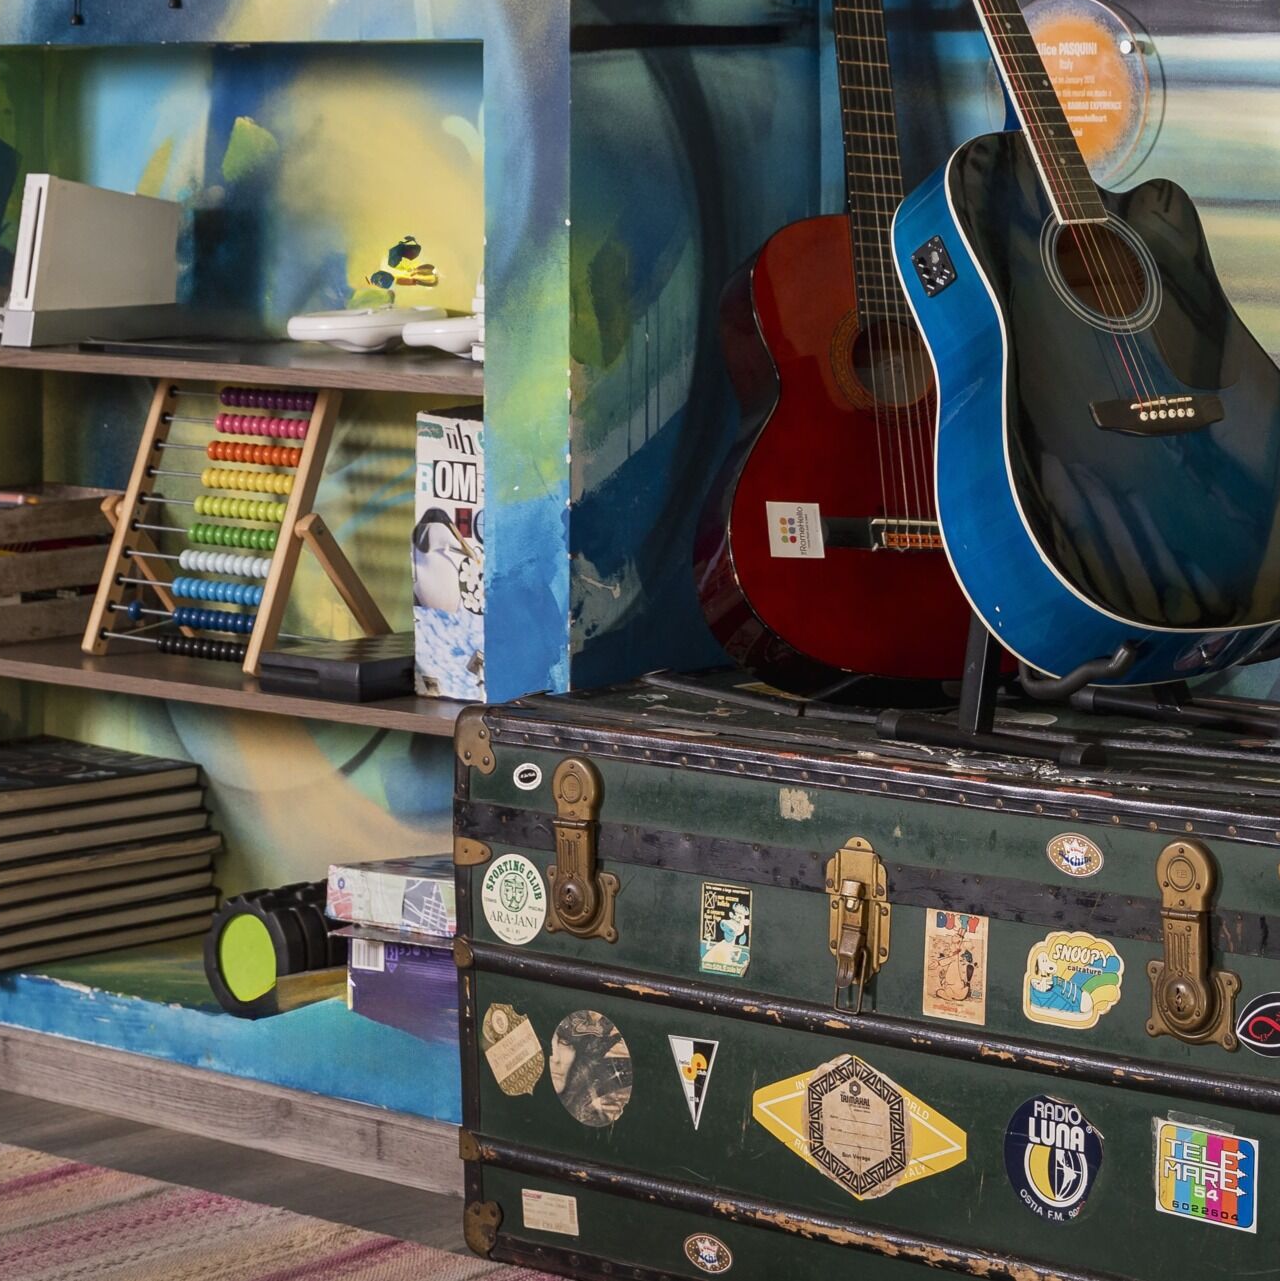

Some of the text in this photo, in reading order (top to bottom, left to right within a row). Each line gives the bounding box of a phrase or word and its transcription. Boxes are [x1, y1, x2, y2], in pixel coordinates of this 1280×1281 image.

[1059, 42, 1097, 56] PASQUINI
[486, 860, 542, 900] SPORTING CLUB
[1052, 944, 1110, 968] SNOOPY
[1067, 965, 1102, 976] calzature
[795, 1080, 806, 1090] IN
[904, 1097, 930, 1120] ORLD
[1034, 1100, 1082, 1125] RADIO
[1028, 1116, 1085, 1153] LUNA
[1165, 1138, 1248, 1180] TELE
[1164, 1156, 1248, 1196] MARE
[1020, 1188, 1043, 1216] OSTIA
[1047, 1210, 1065, 1221] F.M.
[1194, 1185, 1219, 1201] 54
[1172, 1200, 1239, 1220] 6022604
